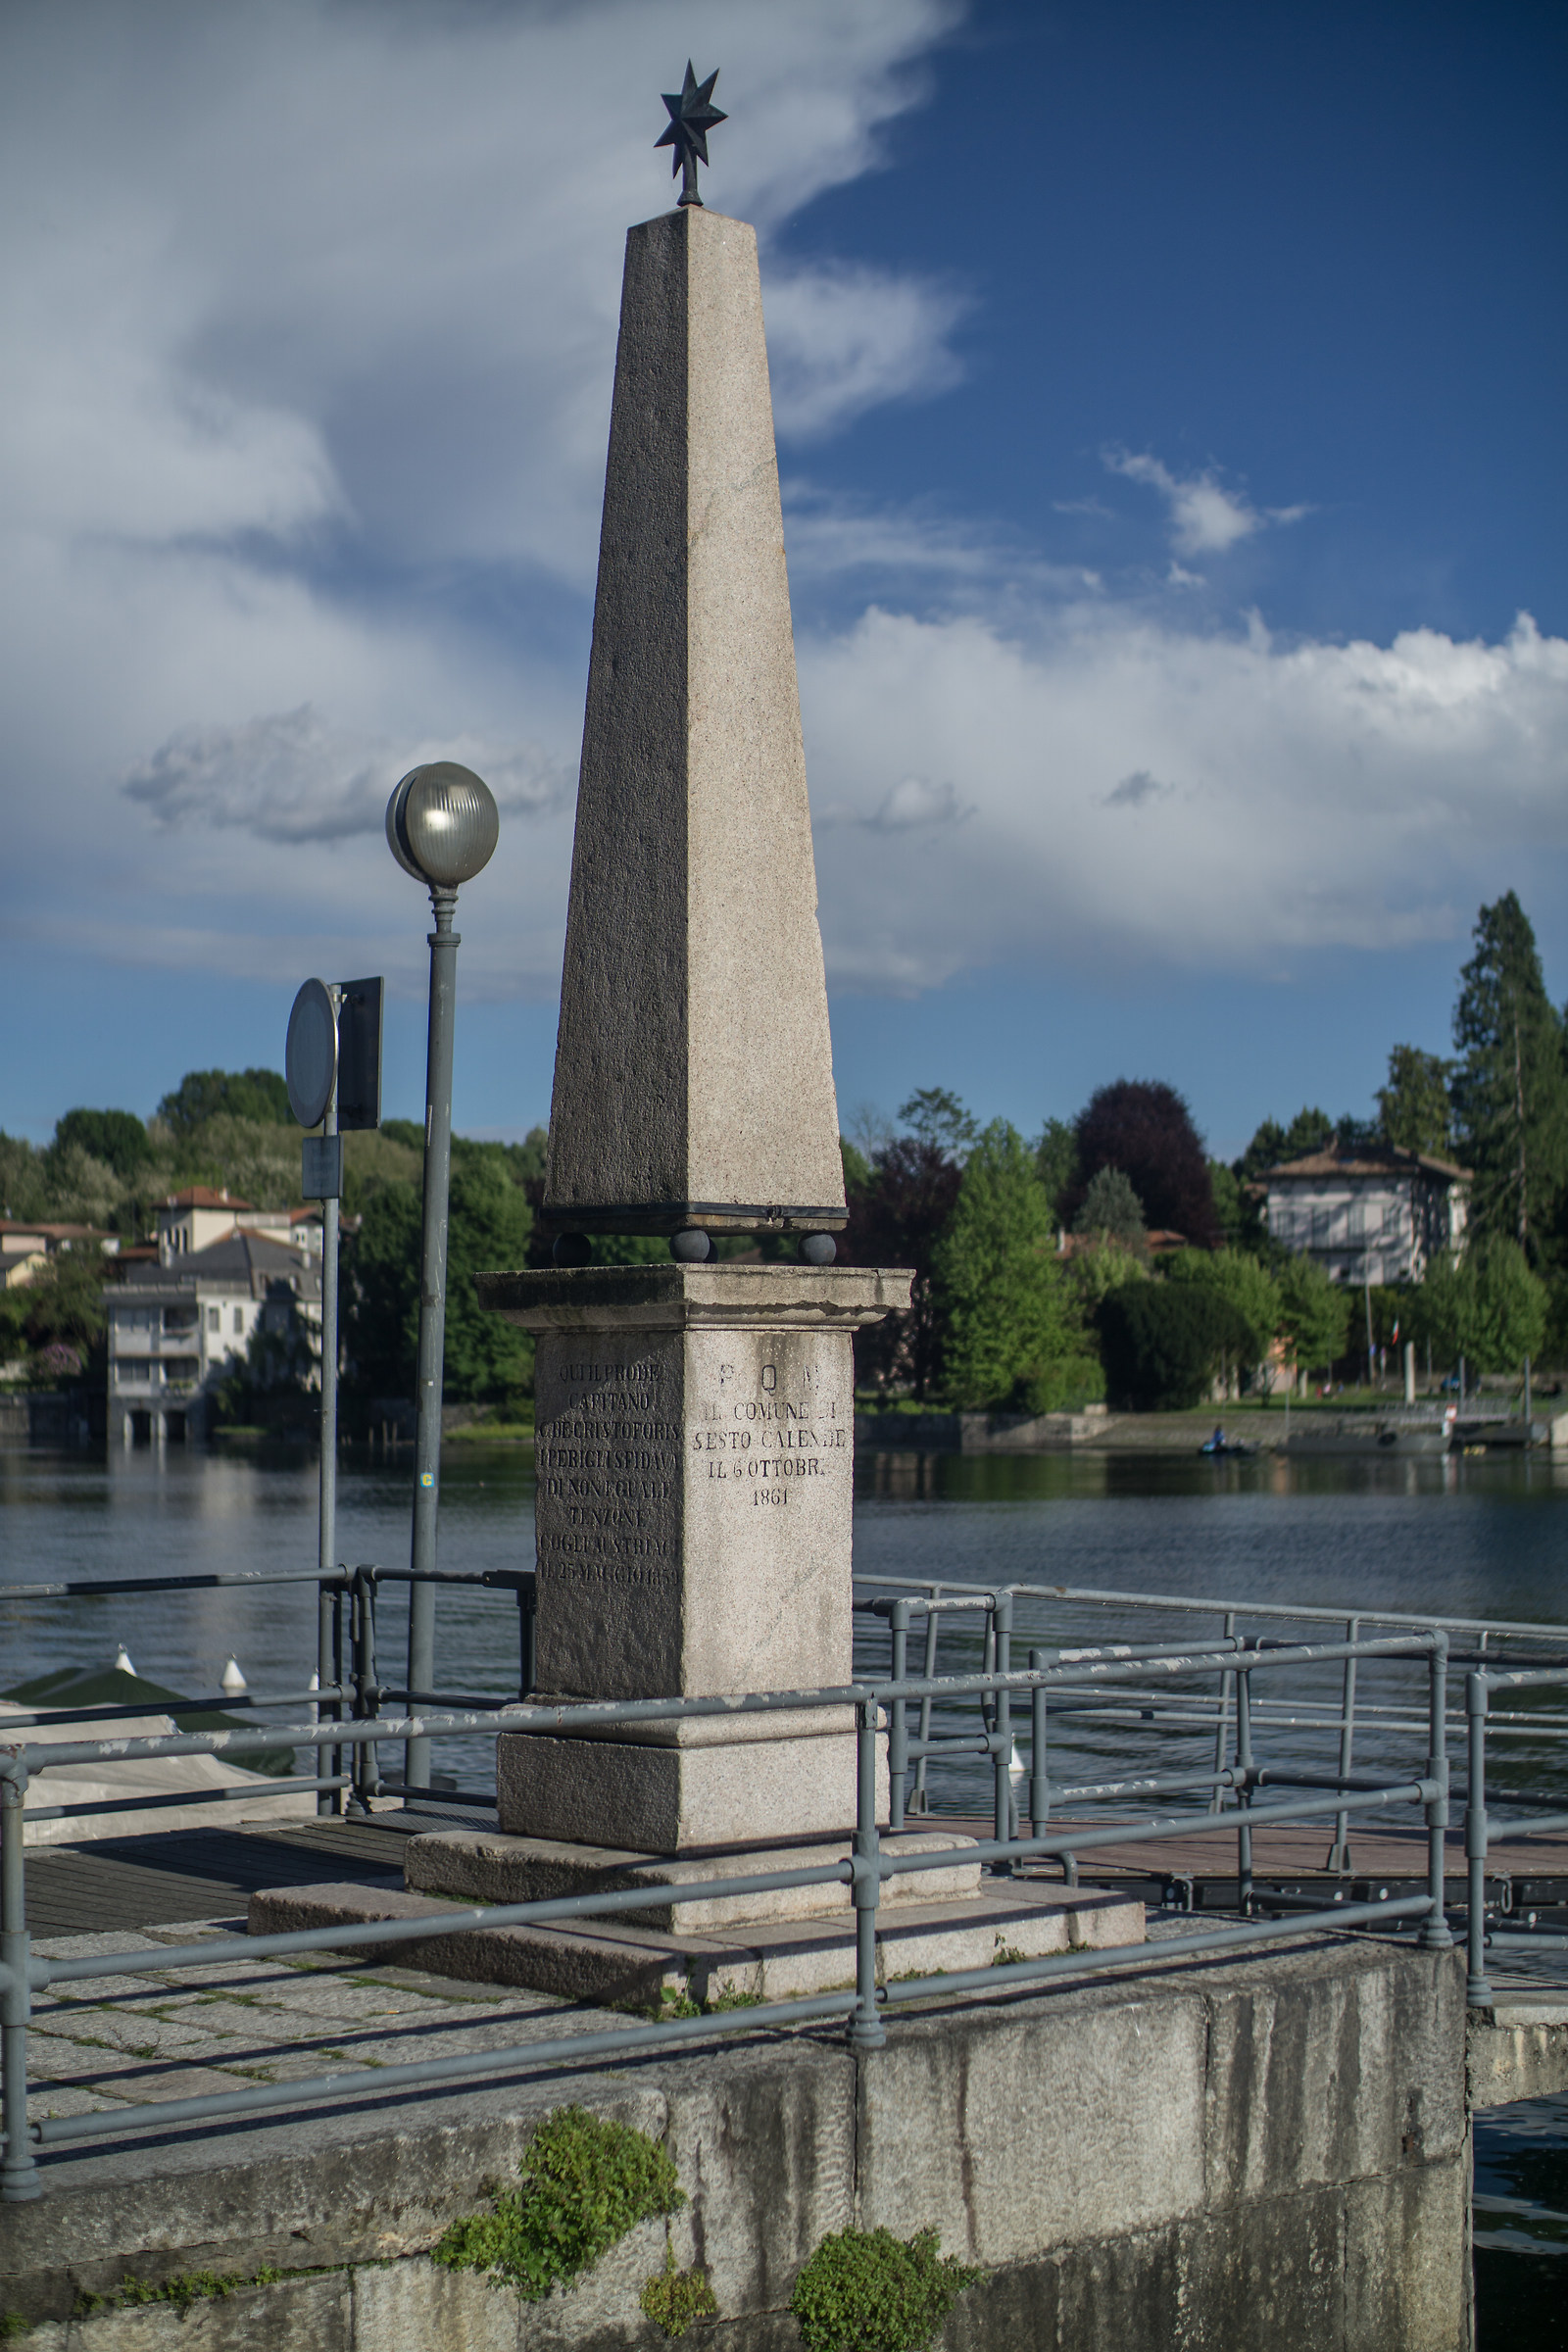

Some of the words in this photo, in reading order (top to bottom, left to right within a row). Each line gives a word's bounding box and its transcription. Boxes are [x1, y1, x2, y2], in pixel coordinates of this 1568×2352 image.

[560, 1363, 584, 1383] QUI
[588, 1364, 601, 1381] IL
[605, 1363, 660, 1382] PRODE
[568, 1393, 650, 1411] CAPITANO
[735, 1401, 808, 1421] COMUNE
[693, 1430, 752, 1450] SESTO
[709, 1461, 727, 1478] IL
[734, 1460, 742, 1478] 6
[753, 1488, 788, 1506] 1861
